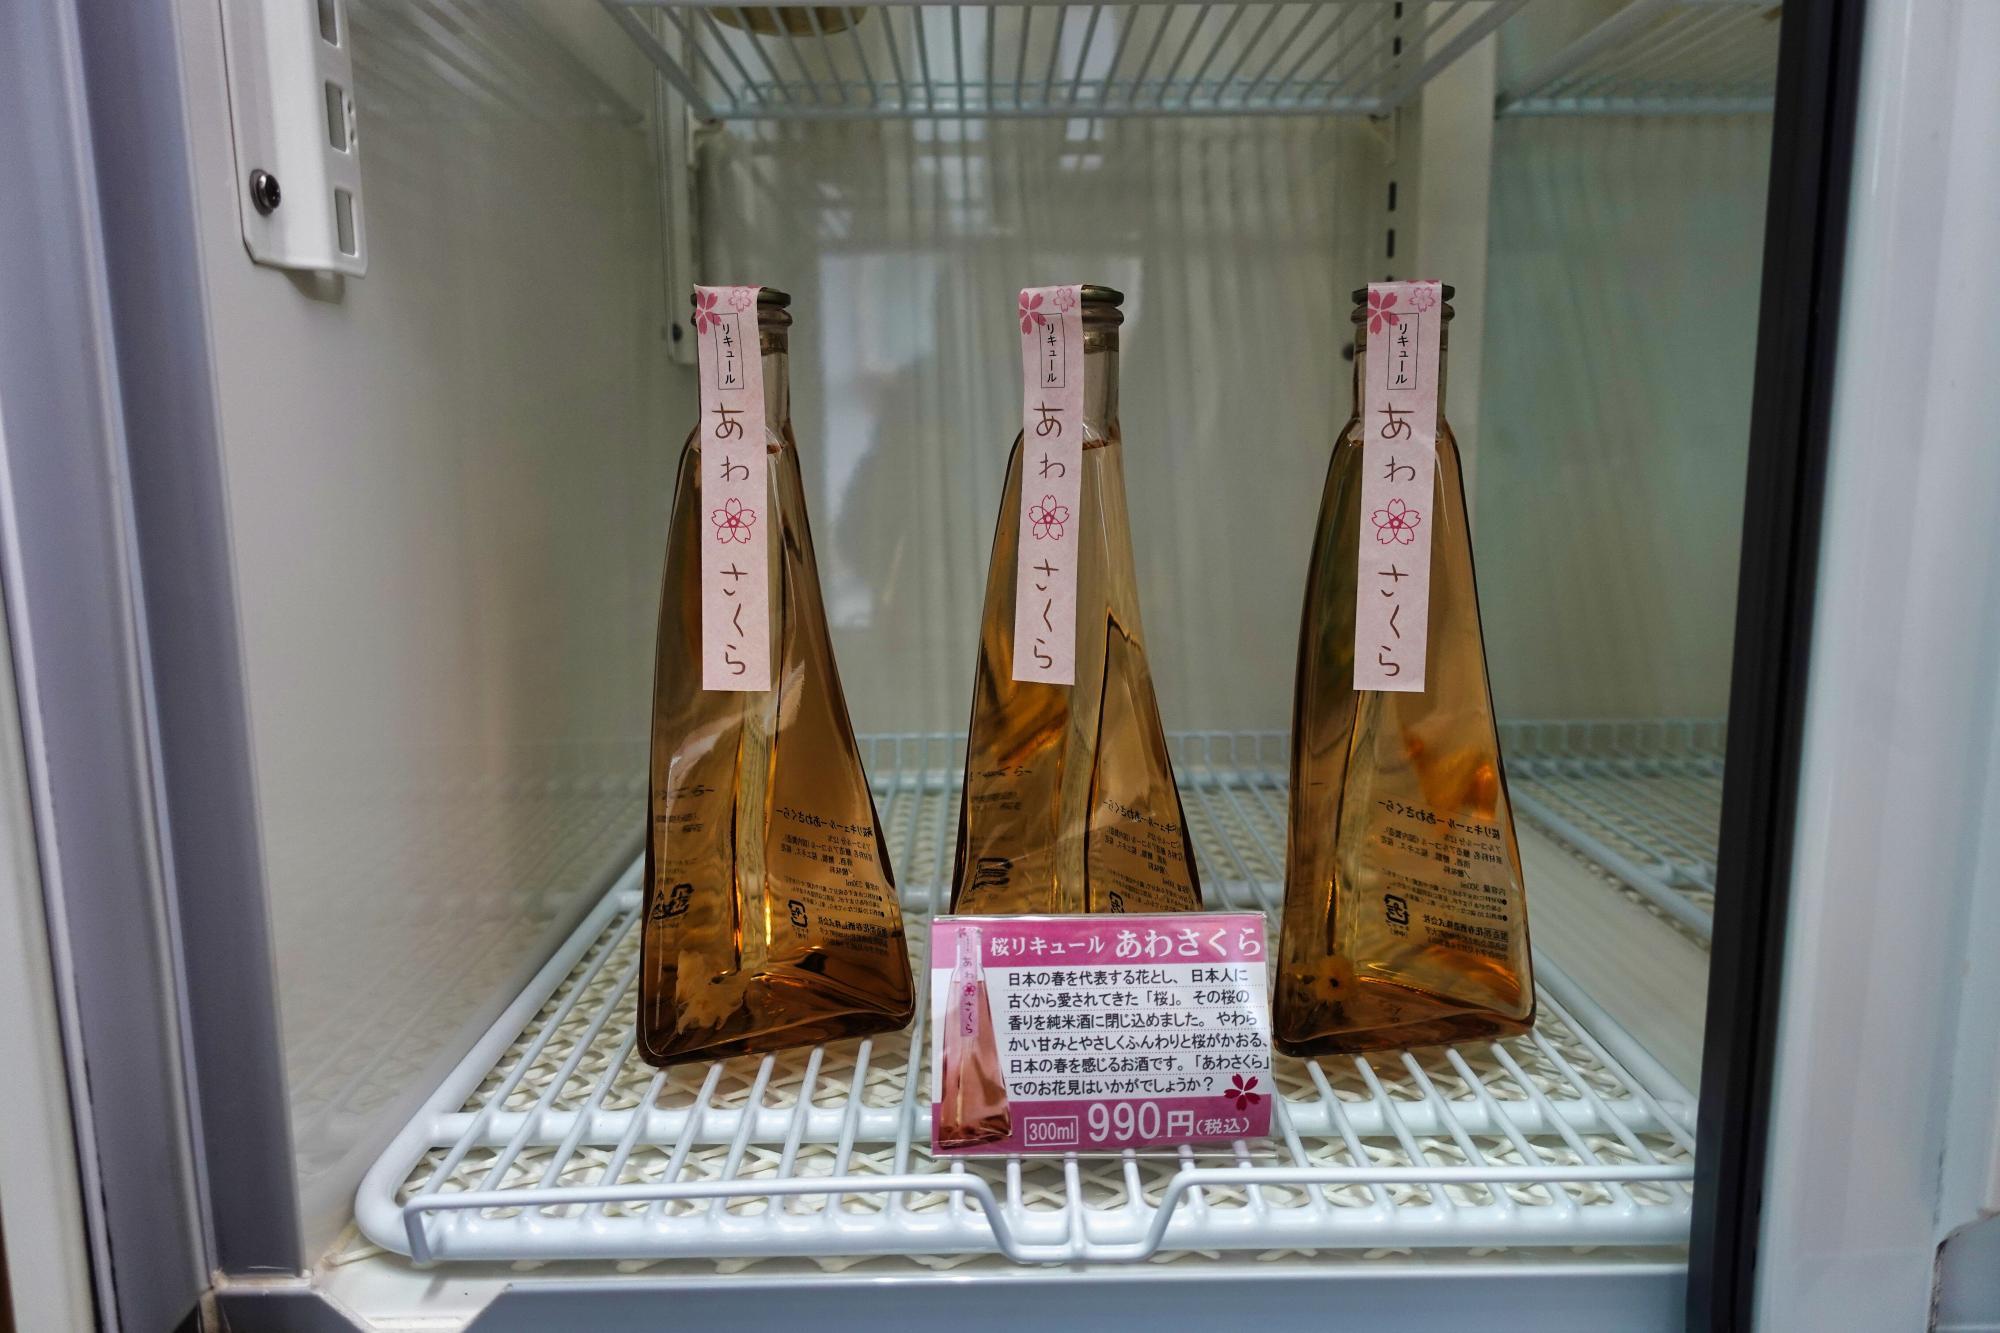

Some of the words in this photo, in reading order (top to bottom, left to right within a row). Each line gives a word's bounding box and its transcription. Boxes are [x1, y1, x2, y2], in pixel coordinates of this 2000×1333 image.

[721, 323, 736, 384] リキュール
[1046, 323, 1057, 383] リキュール
[1396, 323, 1409, 385] リキュール
[990, 937, 1105, 957] 桜リキュール
[1116, 928, 1262, 958] あわさくら
[1029, 1123, 1075, 1142] 300ml
